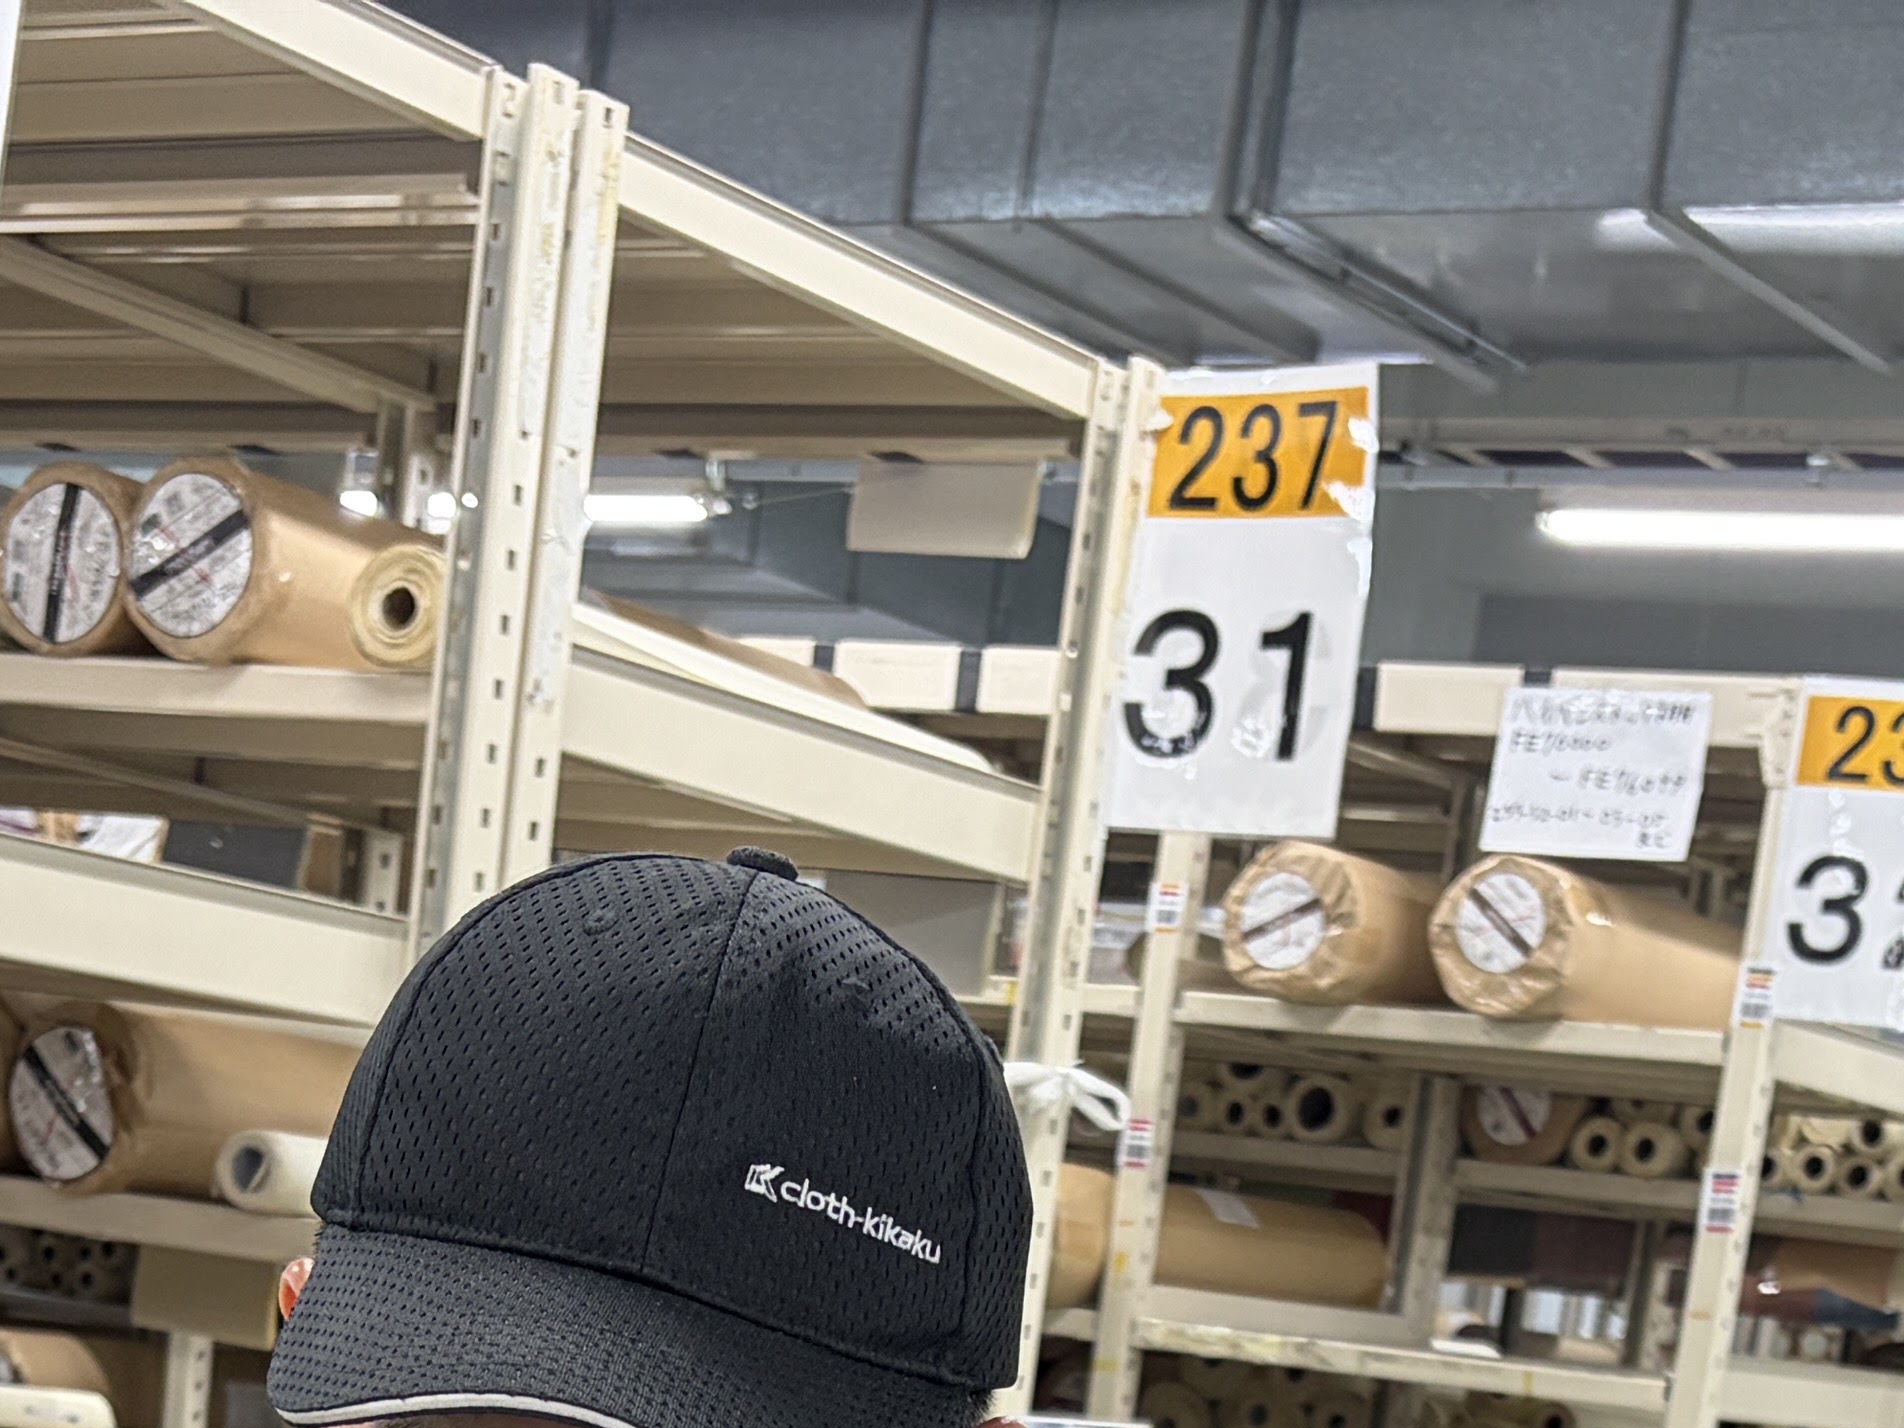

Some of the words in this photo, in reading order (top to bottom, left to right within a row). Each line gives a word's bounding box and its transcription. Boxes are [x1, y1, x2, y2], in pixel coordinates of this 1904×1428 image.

[1168, 400, 1338, 511] 237
[1123, 607, 1313, 762] 31
[780, 1178, 942, 1264] cloth-kikaku
